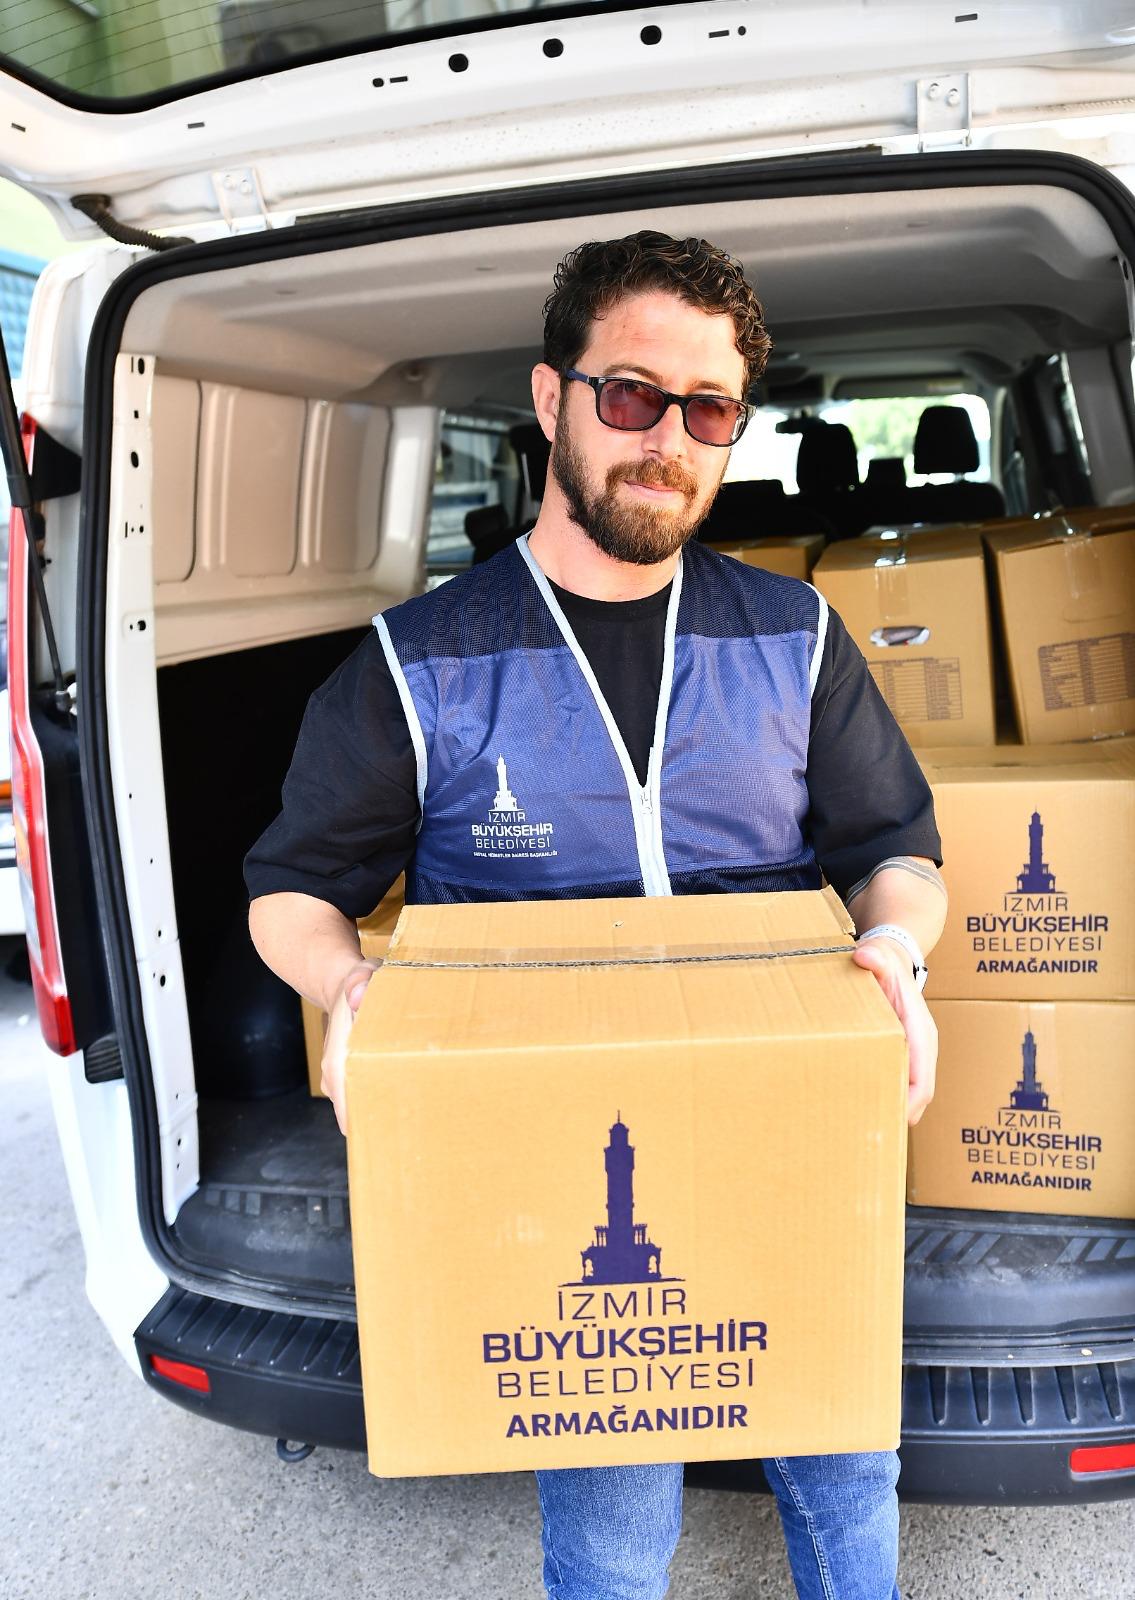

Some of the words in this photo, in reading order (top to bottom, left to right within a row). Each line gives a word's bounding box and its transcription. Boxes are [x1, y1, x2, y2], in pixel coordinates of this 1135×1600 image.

[489, 812, 526, 823] İZMİR
[471, 822, 554, 838] BÜYÜKŞEHİR
[475, 836, 551, 850] BELEDİYESİ
[1003, 895, 1068, 913] İZMİR
[966, 913, 1109, 935] BÜYÜKŞEHİR
[973, 935, 1102, 952] BELEDİYESİ
[976, 957, 1098, 973] ARMAĞANIDIR
[997, 1110, 1063, 1130] İZMİR
[961, 1126, 1103, 1153] BÜYÜKŞEHİR
[967, 1148, 1096, 1171] BELEDİYESİ
[971, 1171, 1093, 1191] ARMAĞANIDIR
[558, 1286, 687, 1321] İZMİR
[482, 1318, 768, 1363] BÜYÜKŞEHİR
[497, 1358, 754, 1399] BELEDİYESİ
[505, 1404, 749, 1438] ARMAĞANIDIR
